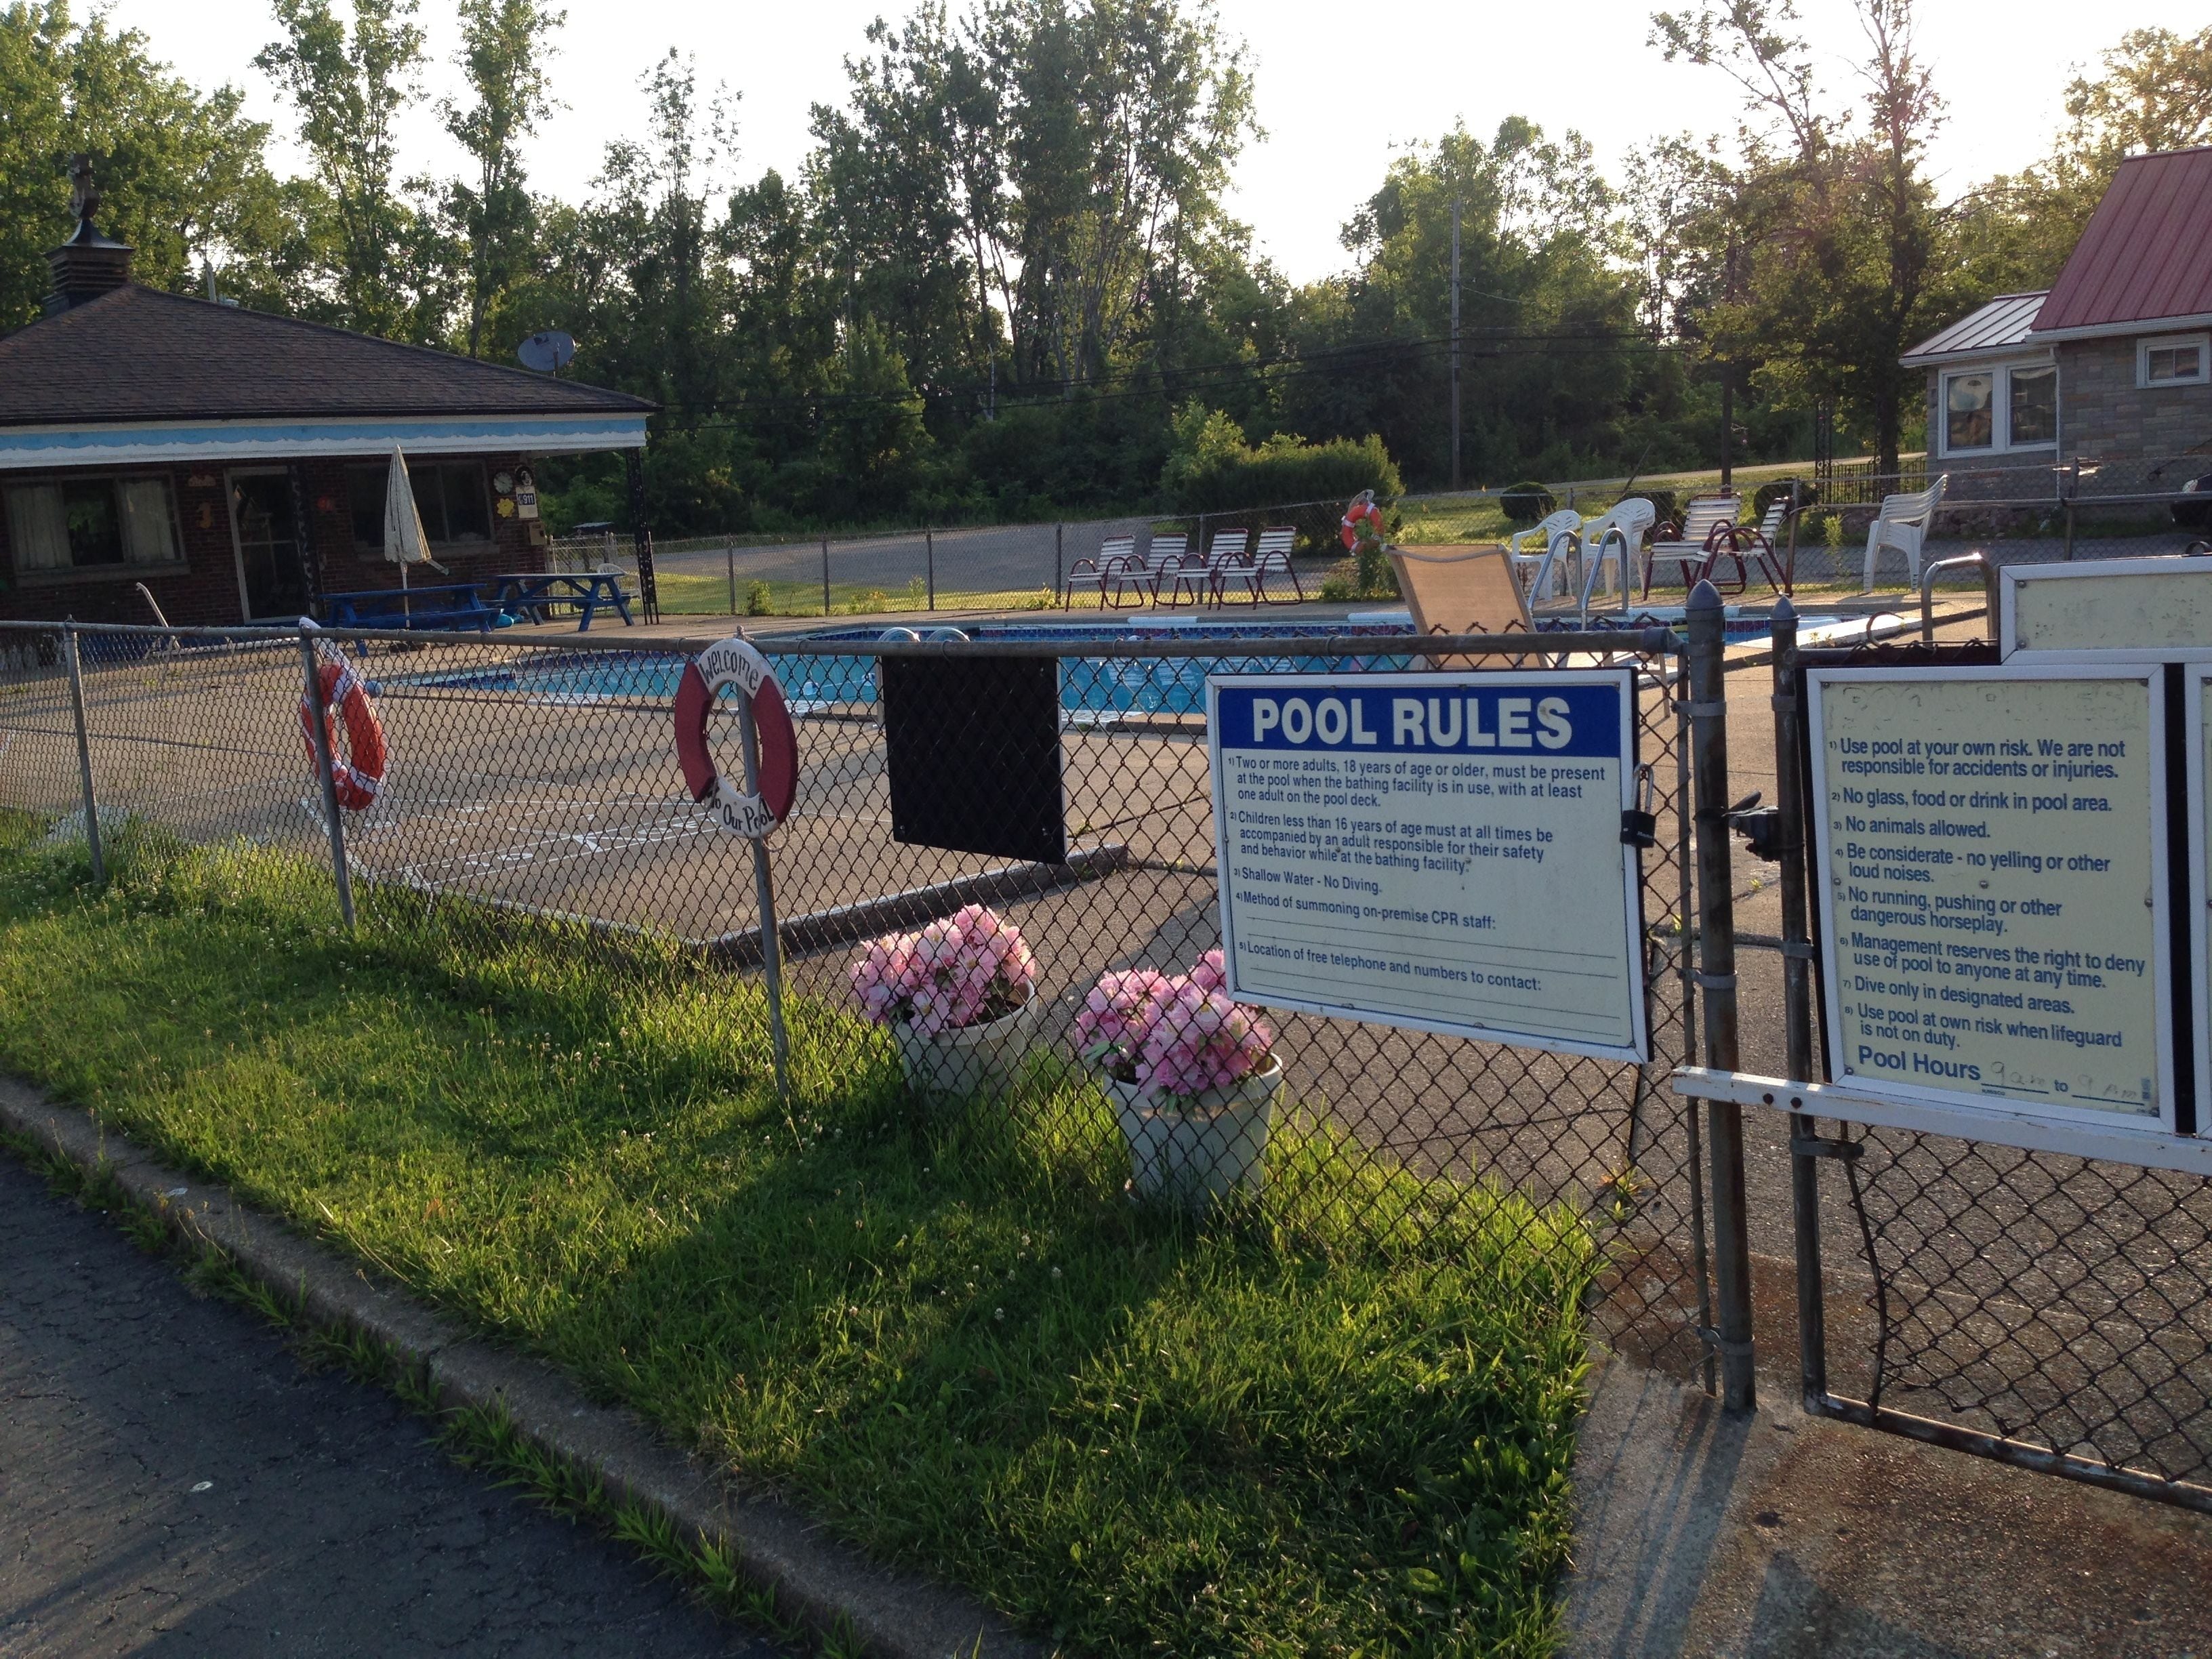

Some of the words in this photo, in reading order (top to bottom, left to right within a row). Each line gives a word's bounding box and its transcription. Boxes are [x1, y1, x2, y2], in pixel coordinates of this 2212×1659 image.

[1253, 697, 1377, 744] POOL
[1392, 697, 1573, 749] RULES
[1840, 737, 1868, 754] Use
[1872, 737, 1903, 758] pool
[1907, 738, 1921, 755] at
[1924, 742, 1959, 759] your
[1962, 742, 1995, 756] own
[2000, 738, 2033, 756] risk.
[2036, 738, 2064, 756] We
[2067, 743, 2093, 756] are
[2097, 739, 2125, 757] not
[1235, 756, 1257, 769] Two
[1259, 759, 1270, 769] or
[1273, 760, 1300, 771] more
[1303, 758, 1340, 773] adults,
[1344, 758, 1356, 772] 18
[1359, 762, 1391, 776] years
[1394, 760, 1407, 774] of
[1410, 764, 1432, 778] age
[1435, 764, 1449, 775] or
[1452, 762, 1488, 779] older,
[1492, 764, 1526, 778] must
[1530, 764, 1547, 779] be
[1551, 766, 1605, 783] present
[1237, 772, 1247, 784] at
[1248, 772, 1265, 785] the
[1267, 773, 1290, 788] pool
[1292, 774, 1322, 787] when
[1324, 775, 1343, 788] the
[1345, 775, 1389, 794] bathing
[1392, 777, 1433, 795] facility
[1467, 783, 1494, 796] use,
[1498, 781, 1526, 796] with
[1530, 783, 1544, 796] at
[1548, 782, 1582, 798] least
[1841, 757, 1925, 777] responsible
[1928, 757, 1950, 775] for
[1952, 758, 2028, 777] accidents
[2031, 763, 2049, 777] or
[2053, 759, 2118, 782] injuries.
[1237, 790, 1256, 800] one
[1258, 787, 1284, 802] adult
[1286, 792, 1300, 802] on
[1303, 790, 1320, 804] the
[1324, 792, 1348, 807] pool
[1350, 792, 1380, 807] deck.
[1843, 787, 1864, 804] No
[1866, 787, 1908, 808] glass,
[1911, 789, 1946, 806] food
[1949, 794, 1966, 807] or
[1969, 790, 2009, 808] drink
[2032, 792, 2068, 814] pool
[2072, 797, 2112, 812] area.
[1238, 811, 1281, 825] Children
[1283, 813, 1305, 827] less
[1307, 815, 1331, 829] than
[1335, 816, 1348, 830] 16
[1350, 820, 1382, 834] years
[1400, 823, 1422, 838] age
[1425, 823, 1456, 837] must
[1460, 824, 1472, 838] at
[1475, 824, 1491, 839] all
[1495, 825, 1532, 842] times
[1536, 827, 1553, 843] be
[1845, 815, 1866, 832] No
[1869, 817, 1926, 835] animals
[1929, 819, 1990, 838] allowed.
[1240, 829, 1307, 844] accompanied
[1309, 830, 1322, 847] by
[1325, 834, 1338, 845] an
[1341, 833, 1370, 848] adult
[1374, 838, 1444, 853] responsible
[1447, 840, 1465, 855] for
[1469, 841, 1499, 857] their
[1502, 844, 1544, 864] safety
[1241, 842, 1259, 855] and
[1261, 842, 1306, 859] behavior
[1309, 847, 1338, 862] while
[1340, 850, 1351, 863] at
[1354, 850, 1372, 864] the
[1374, 851, 1420, 872] bathing
[1847, 842, 1866, 859] Be
[1869, 845, 1954, 864] considerate
[1967, 852, 1986, 865] no
[1990, 850, 2042, 873] yelling
[2046, 856, 2064, 869] or
[2067, 854, 2111, 872] other
[1242, 867, 1281, 882] Shallow
[1283, 870, 1314, 886] Water
[1324, 874, 1340, 888] No
[1342, 876, 1381, 895] Diving.
[1849, 861, 1880, 878] loud
[1883, 864, 1935, 882] noises.
[1244, 890, 1280, 907] Method
[1282, 895, 1292, 908] of
[1296, 899, 1360, 918] summoning
[1363, 906, 1429, 922] on-premise
[1431, 909, 1458, 926] CPR
[1462, 914, 1496, 930] staff:
[1848, 886, 1868, 903] No
[1872, 889, 1931, 911] running,
[1935, 893, 1996, 916] pushing
[1999, 899, 2017, 914] or
[2020, 898, 2062, 917] other
[1850, 904, 1927, 927] dangerous
[1929, 910, 2008, 937] horseplay.
[1247, 941, 1291, 958] Location
[1293, 947, 1304, 960] of
[1307, 948, 1328, 963] free
[1330, 951, 1387, 970] telephone
[1389, 960, 1411, 974] and
[1414, 965, 1468, 981] numbers
[1471, 969, 1484, 983] to
[1487, 974, 1541, 991] contact:
[1851, 932, 1943, 956] Management
[1946, 943, 2011, 961] reserves
[2014, 946, 2040, 964] the
[2044, 948, 2081, 970] right
[2085, 952, 2102, 969] to
[2104, 953, 2146, 977] deny
[1853, 953, 1881, 967] use
[1883, 953, 1898, 968] of
[1902, 956, 1933, 974] pool
[1936, 958, 1951, 974] to
[1955, 962, 2011, 981] anyone
[2015, 965, 2030, 981] at
[2034, 970, 2064, 989] any
[2066, 969, 2106, 989] time.
[1854, 975, 1885, 994] Dive
[1889, 981, 1919, 1001] only
[1940, 984, 2024, 1008] designated
[2028, 997, 2074, 1015] areas.
[1858, 1003, 1885, 1021] Use
[1887, 1008, 1919, 1026] pool
[1923, 1011, 1937, 1027] at
[1940, 1015, 1971, 1030] own
[1975, 1016, 2003, 1034] risk
[2006, 1021, 2049, 1039] when
[2051, 1024, 2122, 1048] lifeguard
[1876, 1024, 1899, 1039] not
[1902, 1029, 1921, 1042] on
[1924, 1027, 1960, 1050] duty.
[1858, 1045, 1906, 1070] Pool
[1913, 1052, 1981, 1081] Hours
[2054, 1080, 2069, 1092] to
